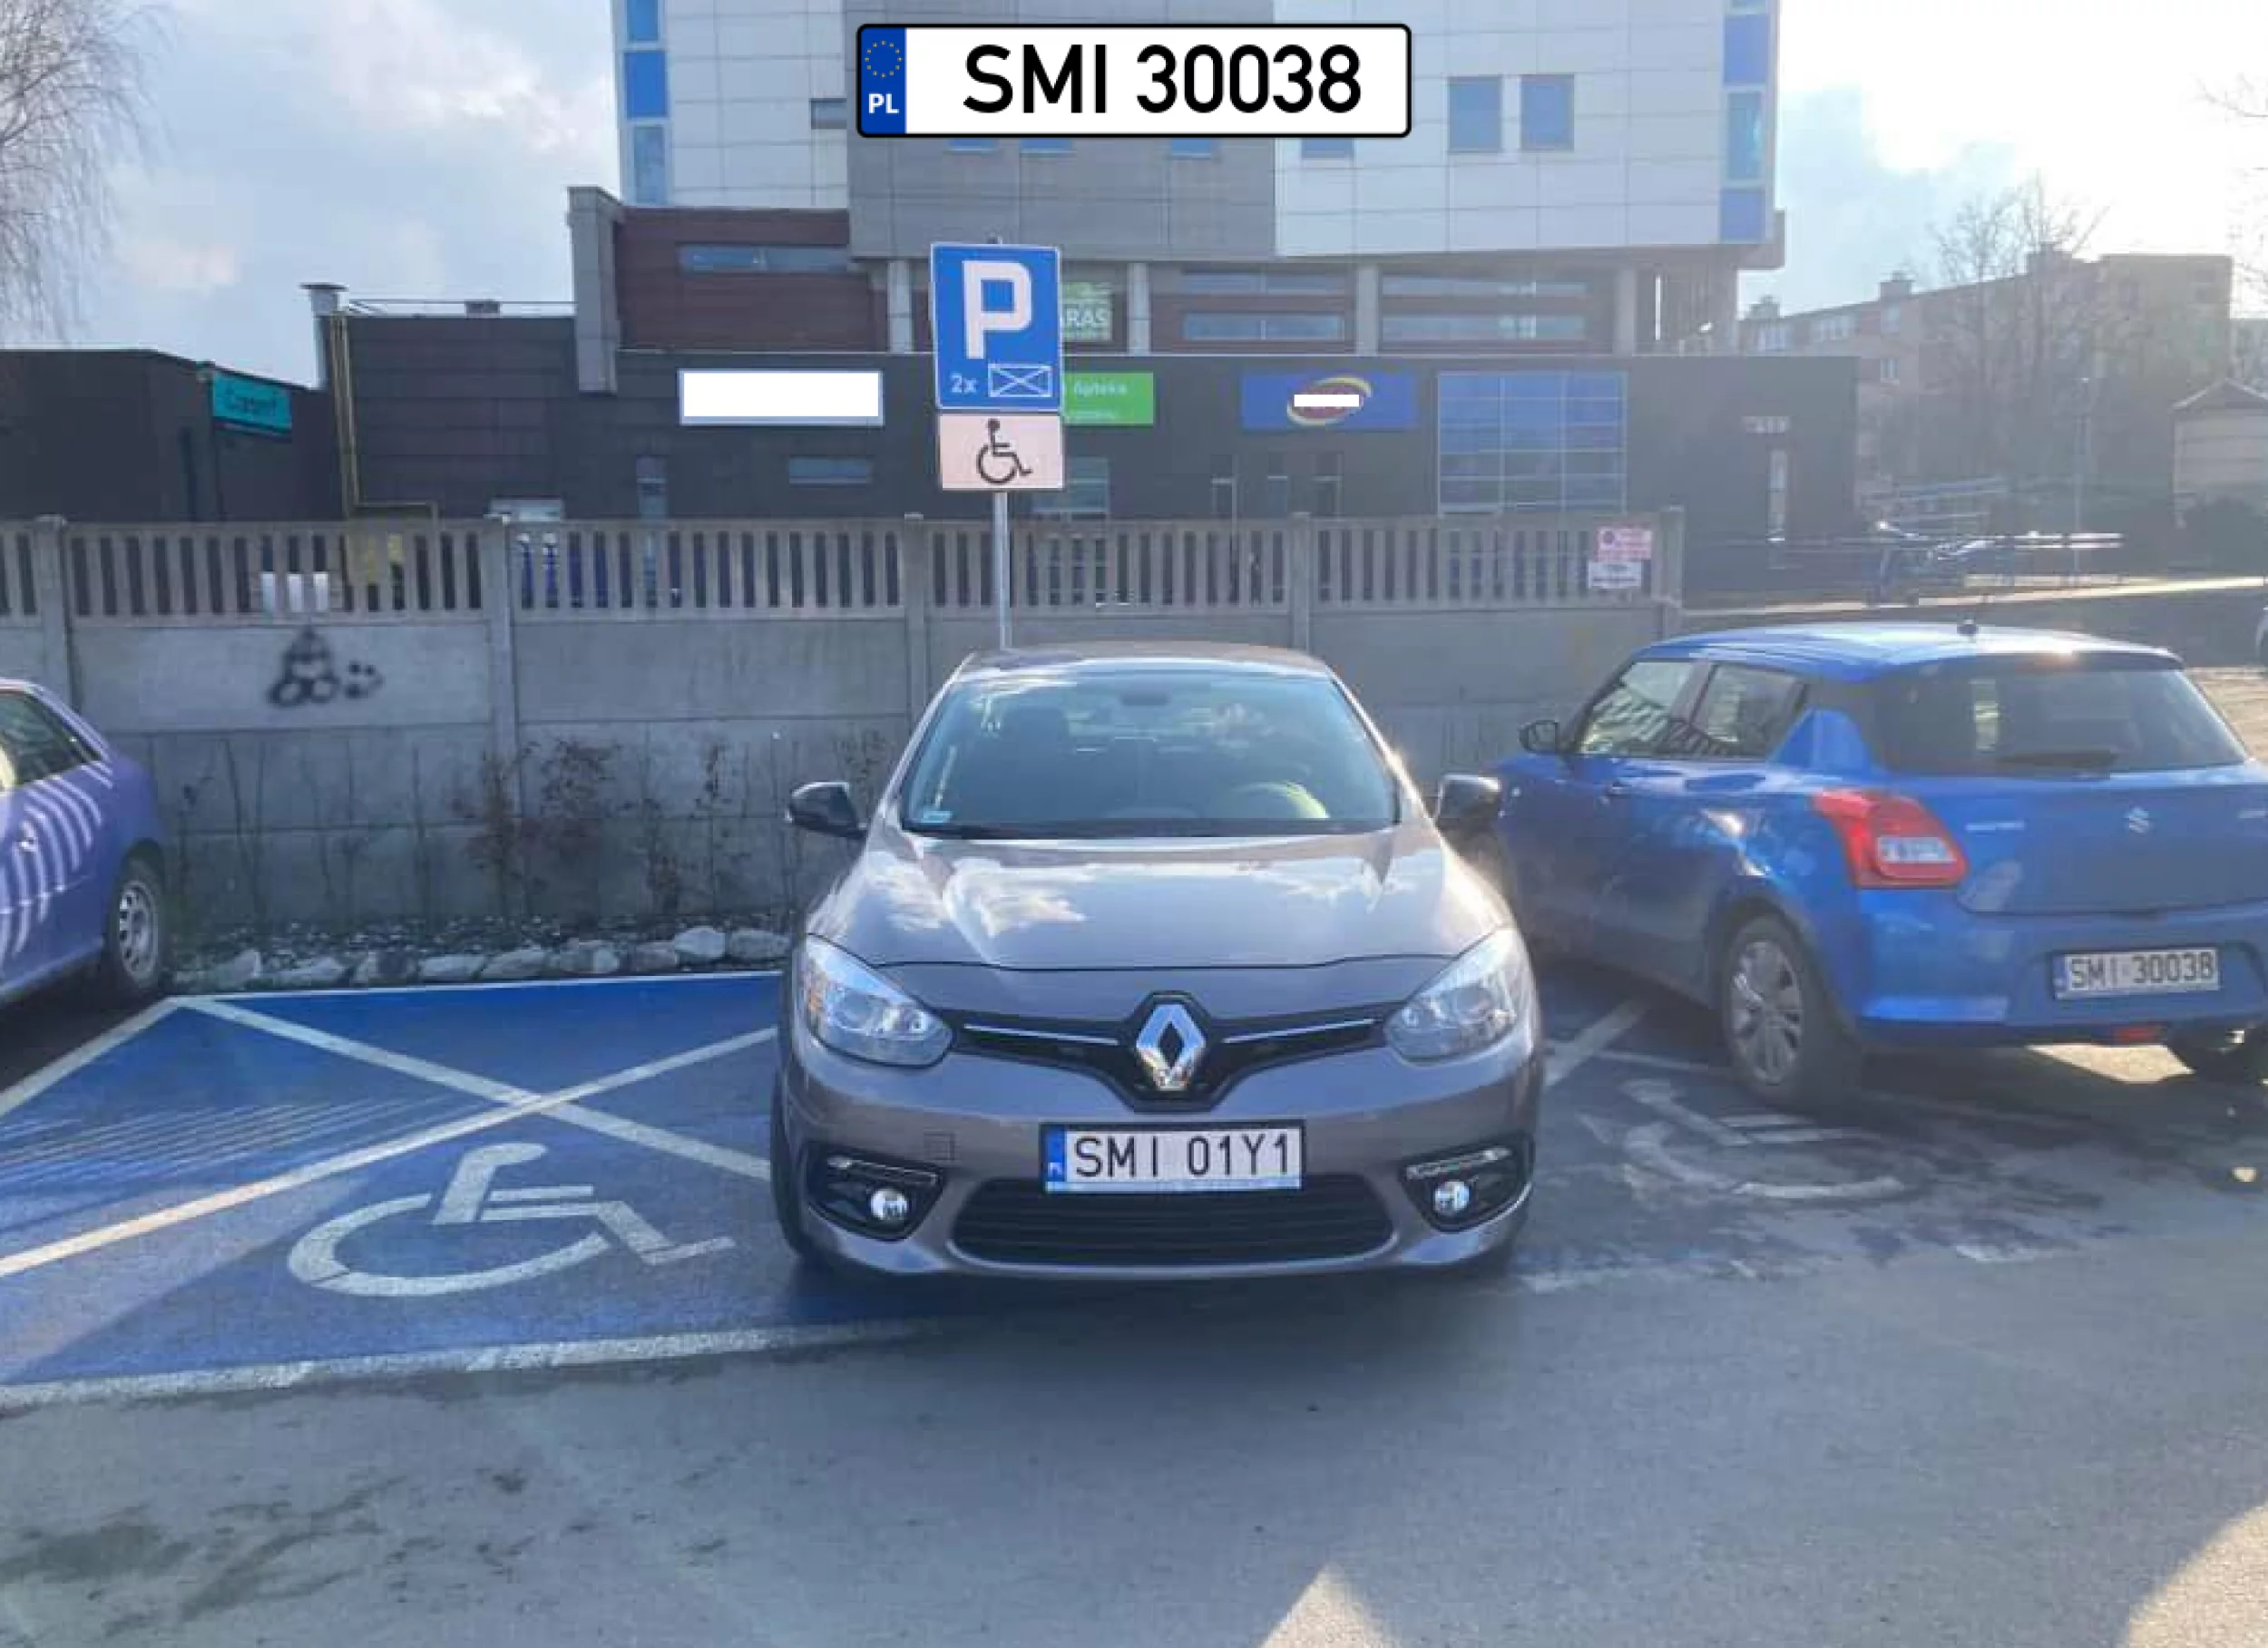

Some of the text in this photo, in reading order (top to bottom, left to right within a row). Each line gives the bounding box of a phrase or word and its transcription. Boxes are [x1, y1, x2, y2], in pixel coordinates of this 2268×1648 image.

[963, 260, 1031, 359] P
[950, 373, 977, 394] 2x
[2071, 951, 2214, 990] SMI 30038
[1075, 1133, 1288, 1177] SMI 01Y1
